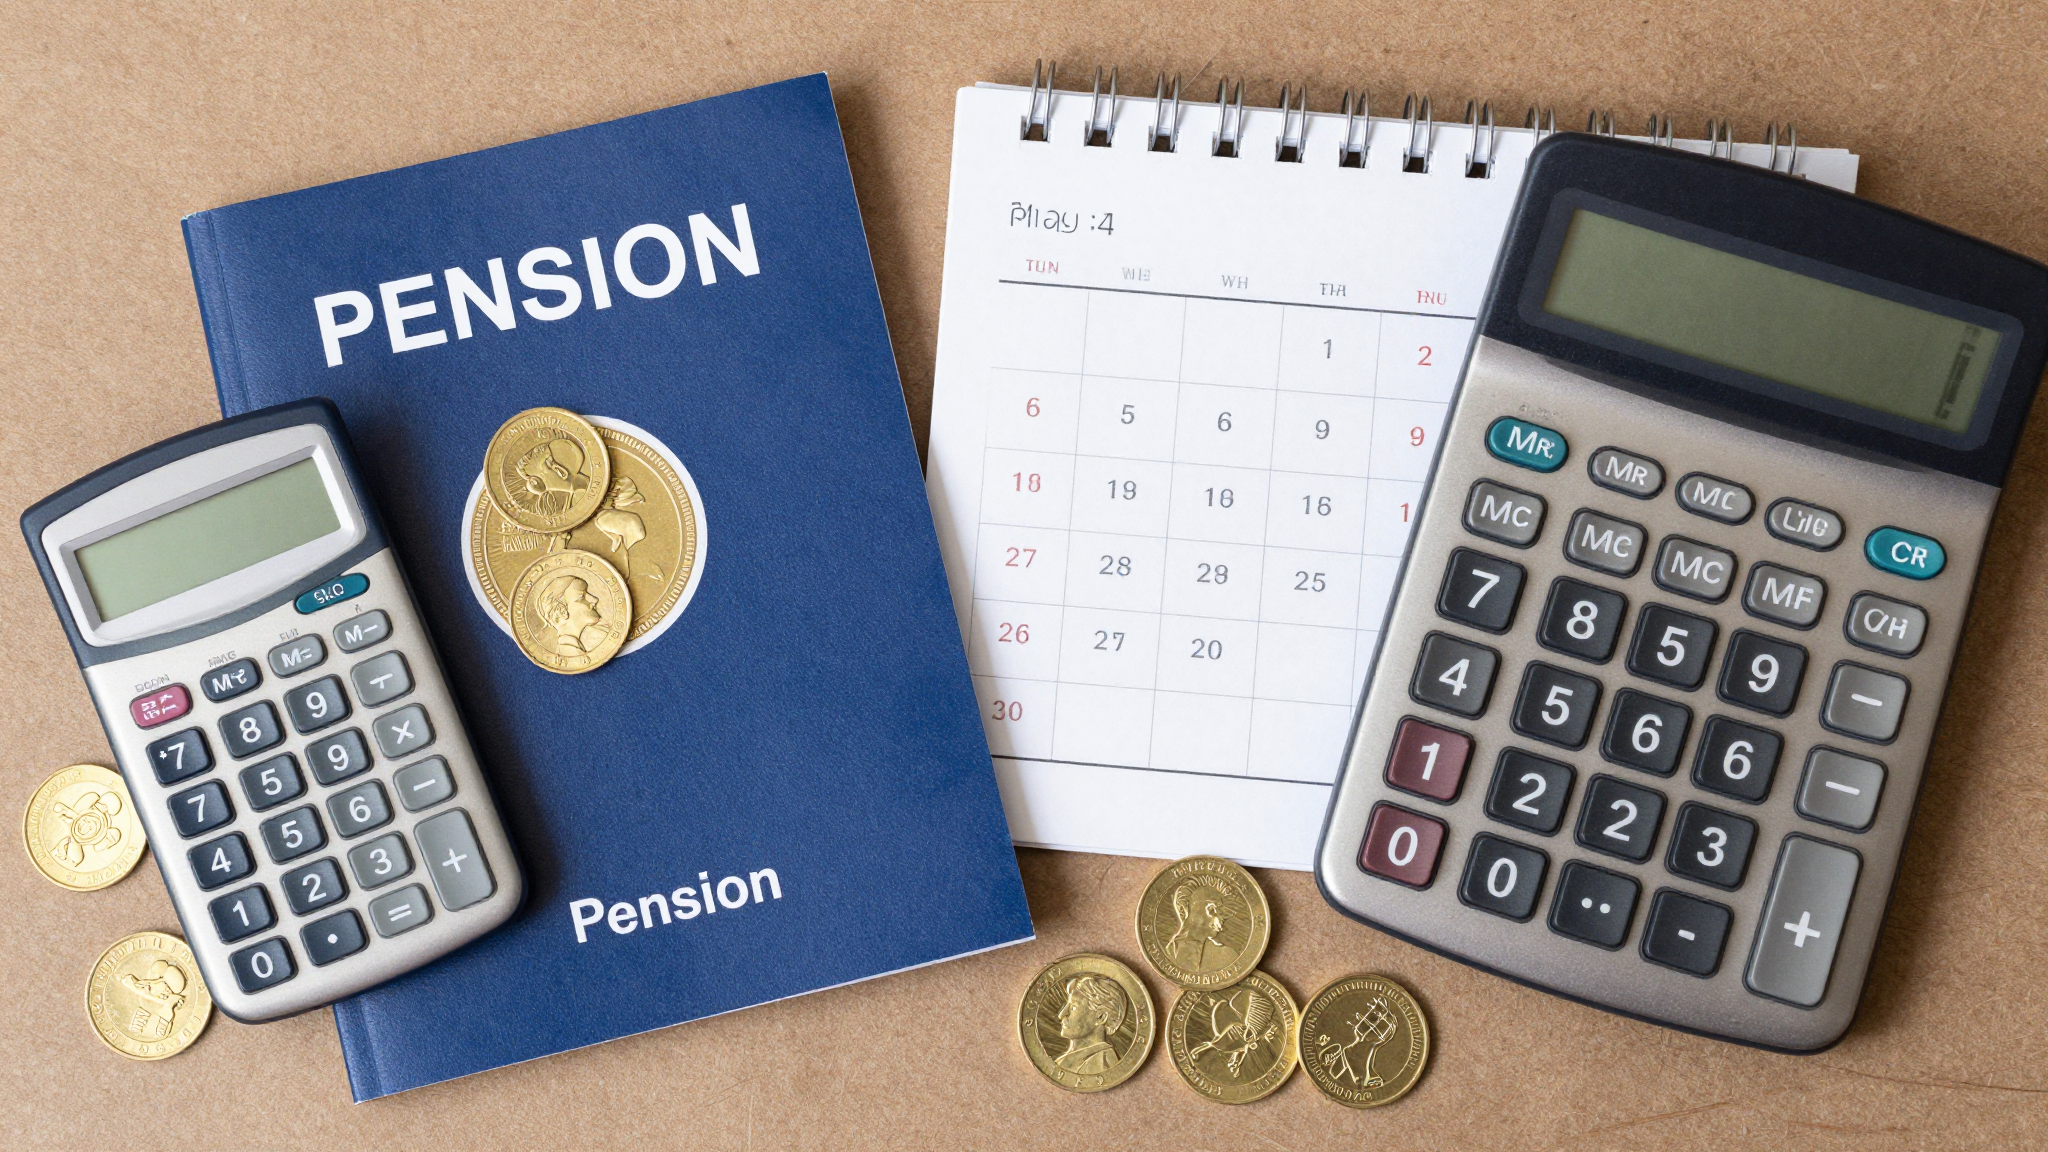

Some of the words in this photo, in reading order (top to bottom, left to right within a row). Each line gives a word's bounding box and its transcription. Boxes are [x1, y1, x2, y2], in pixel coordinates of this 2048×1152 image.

[314, 203, 760, 367] PENSION
[1324, 339, 1331, 358] 1
[1418, 346, 1431, 366] 2
[1027, 398, 1040, 417] 6
[1121, 405, 1134, 424] 5
[1218, 412, 1231, 431] 6
[1316, 420, 1329, 439] 9
[1411, 427, 1424, 446] 9
[1014, 472, 1040, 492] 18
[1694, 482, 1735, 509] MC
[1481, 496, 1531, 527] MC
[1582, 525, 1631, 557] MC
[1892, 542, 1927, 568] CR
[1006, 547, 1036, 567] 27
[1100, 555, 1131, 576] 28
[1294, 571, 1325, 592] 25
[1671, 551, 1723, 583] MC
[1471, 568, 1500, 609] 7
[1565, 600, 1598, 640] 8
[999, 623, 1028, 643] 26
[1094, 631, 1124, 651] 27
[1191, 639, 1222, 659] 20
[1658, 626, 1688, 666] 5
[1439, 659, 1469, 696] 4
[1749, 654, 1778, 692] 9
[306, 692, 327, 718] 9
[991, 700, 1023, 722] 30
[1542, 686, 1573, 725] 5
[240, 717, 261, 742] 8
[1633, 714, 1662, 752] 6
[328, 745, 349, 771] 9
[1422, 743, 1440, 780] 1
[1724, 741, 1753, 779] 6
[261, 768, 282, 795] 5
[1513, 773, 1546, 814] 2
[188, 794, 205, 822] 7
[350, 796, 371, 822] 6
[1603, 800, 1637, 841] 2
[282, 820, 302, 848] 5
[1388, 827, 1417, 866] 0
[1698, 827, 1726, 866] 3
[212, 848, 231, 872] 4
[370, 849, 392, 874] 3
[303, 874, 326, 902] 2
[1488, 858, 1517, 897] 0
[233, 901, 249, 926] 1
[570, 869, 781, 943] Pension
[252, 952, 273, 978] 0
